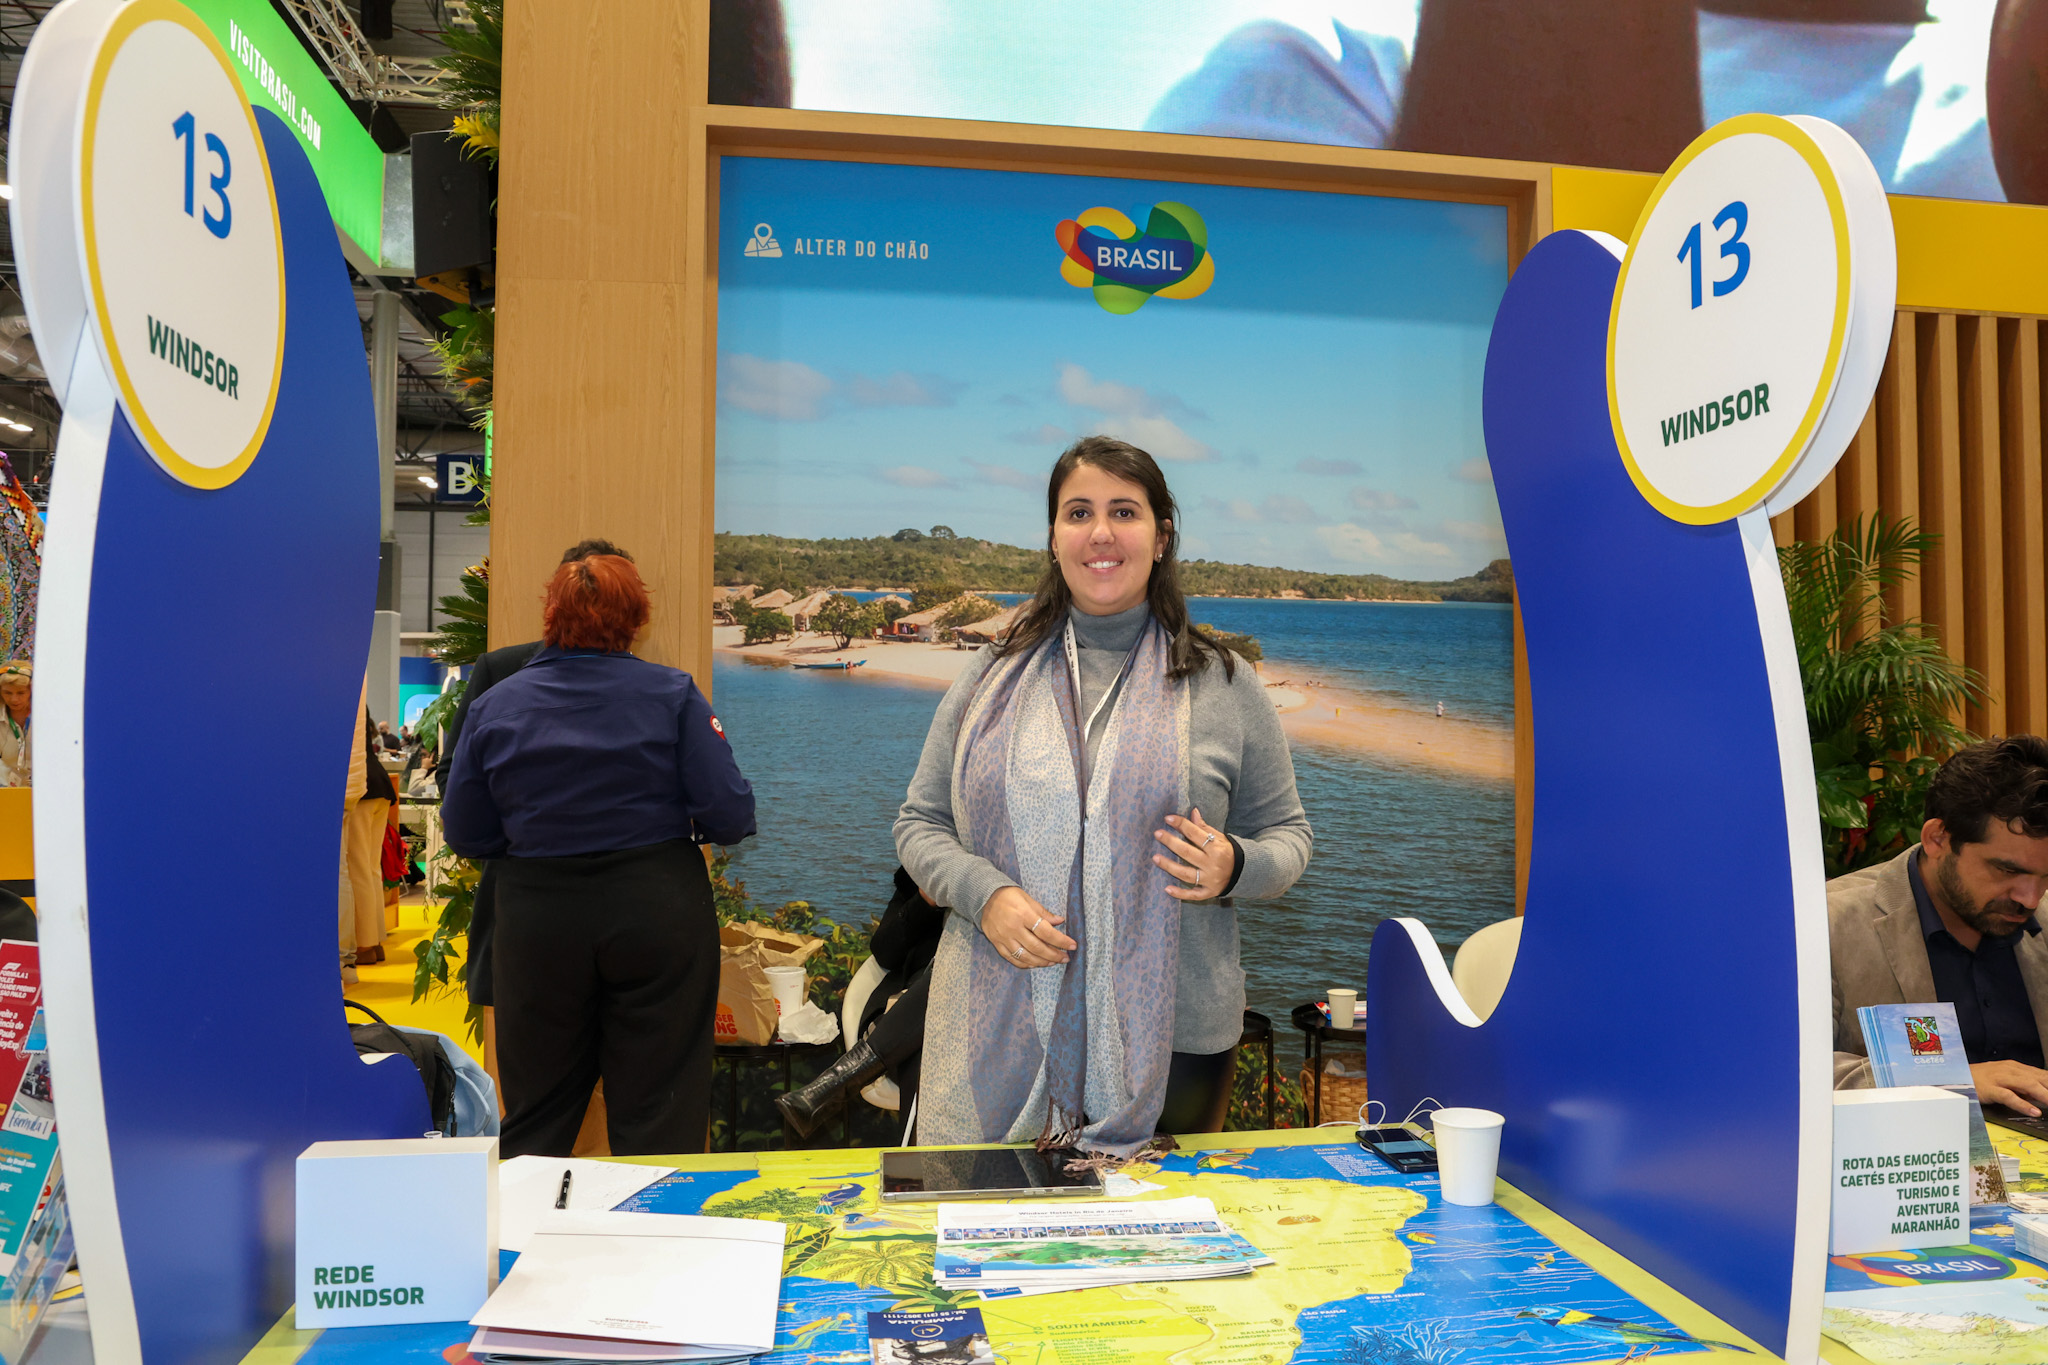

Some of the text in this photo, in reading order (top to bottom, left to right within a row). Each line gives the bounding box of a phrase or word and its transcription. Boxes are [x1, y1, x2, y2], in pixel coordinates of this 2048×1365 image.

[229, 18, 321, 151] VISITBRASIL.COM
[171, 110, 232, 239] 13
[794, 238, 929, 260] ALTER DO CHÃO
[1097, 246, 1183, 272] BRASIL
[1677, 200, 1751, 310] 13
[147, 314, 239, 400] WINDSOR
[1660, 382, 1771, 448] WINDSOR
[715, 1014, 735, 1023] GER
[1842, 1150, 1960, 1171] ROTA DAS EMOÇÕES
[1840, 1166, 1960, 1187] CAETÉS EXPEDIÇÕES
[1896, 1184, 1960, 1200] TURISMO E
[1896, 1201, 1960, 1217] AVENTURA
[1891, 1216, 1960, 1234] MARANHÃO
[314, 1265, 374, 1285] REDE
[1893, 1260, 2001, 1276] BRASIL
[313, 1287, 424, 1309] WINDSOR
[888, 1316, 964, 1324] PAMPULHA
